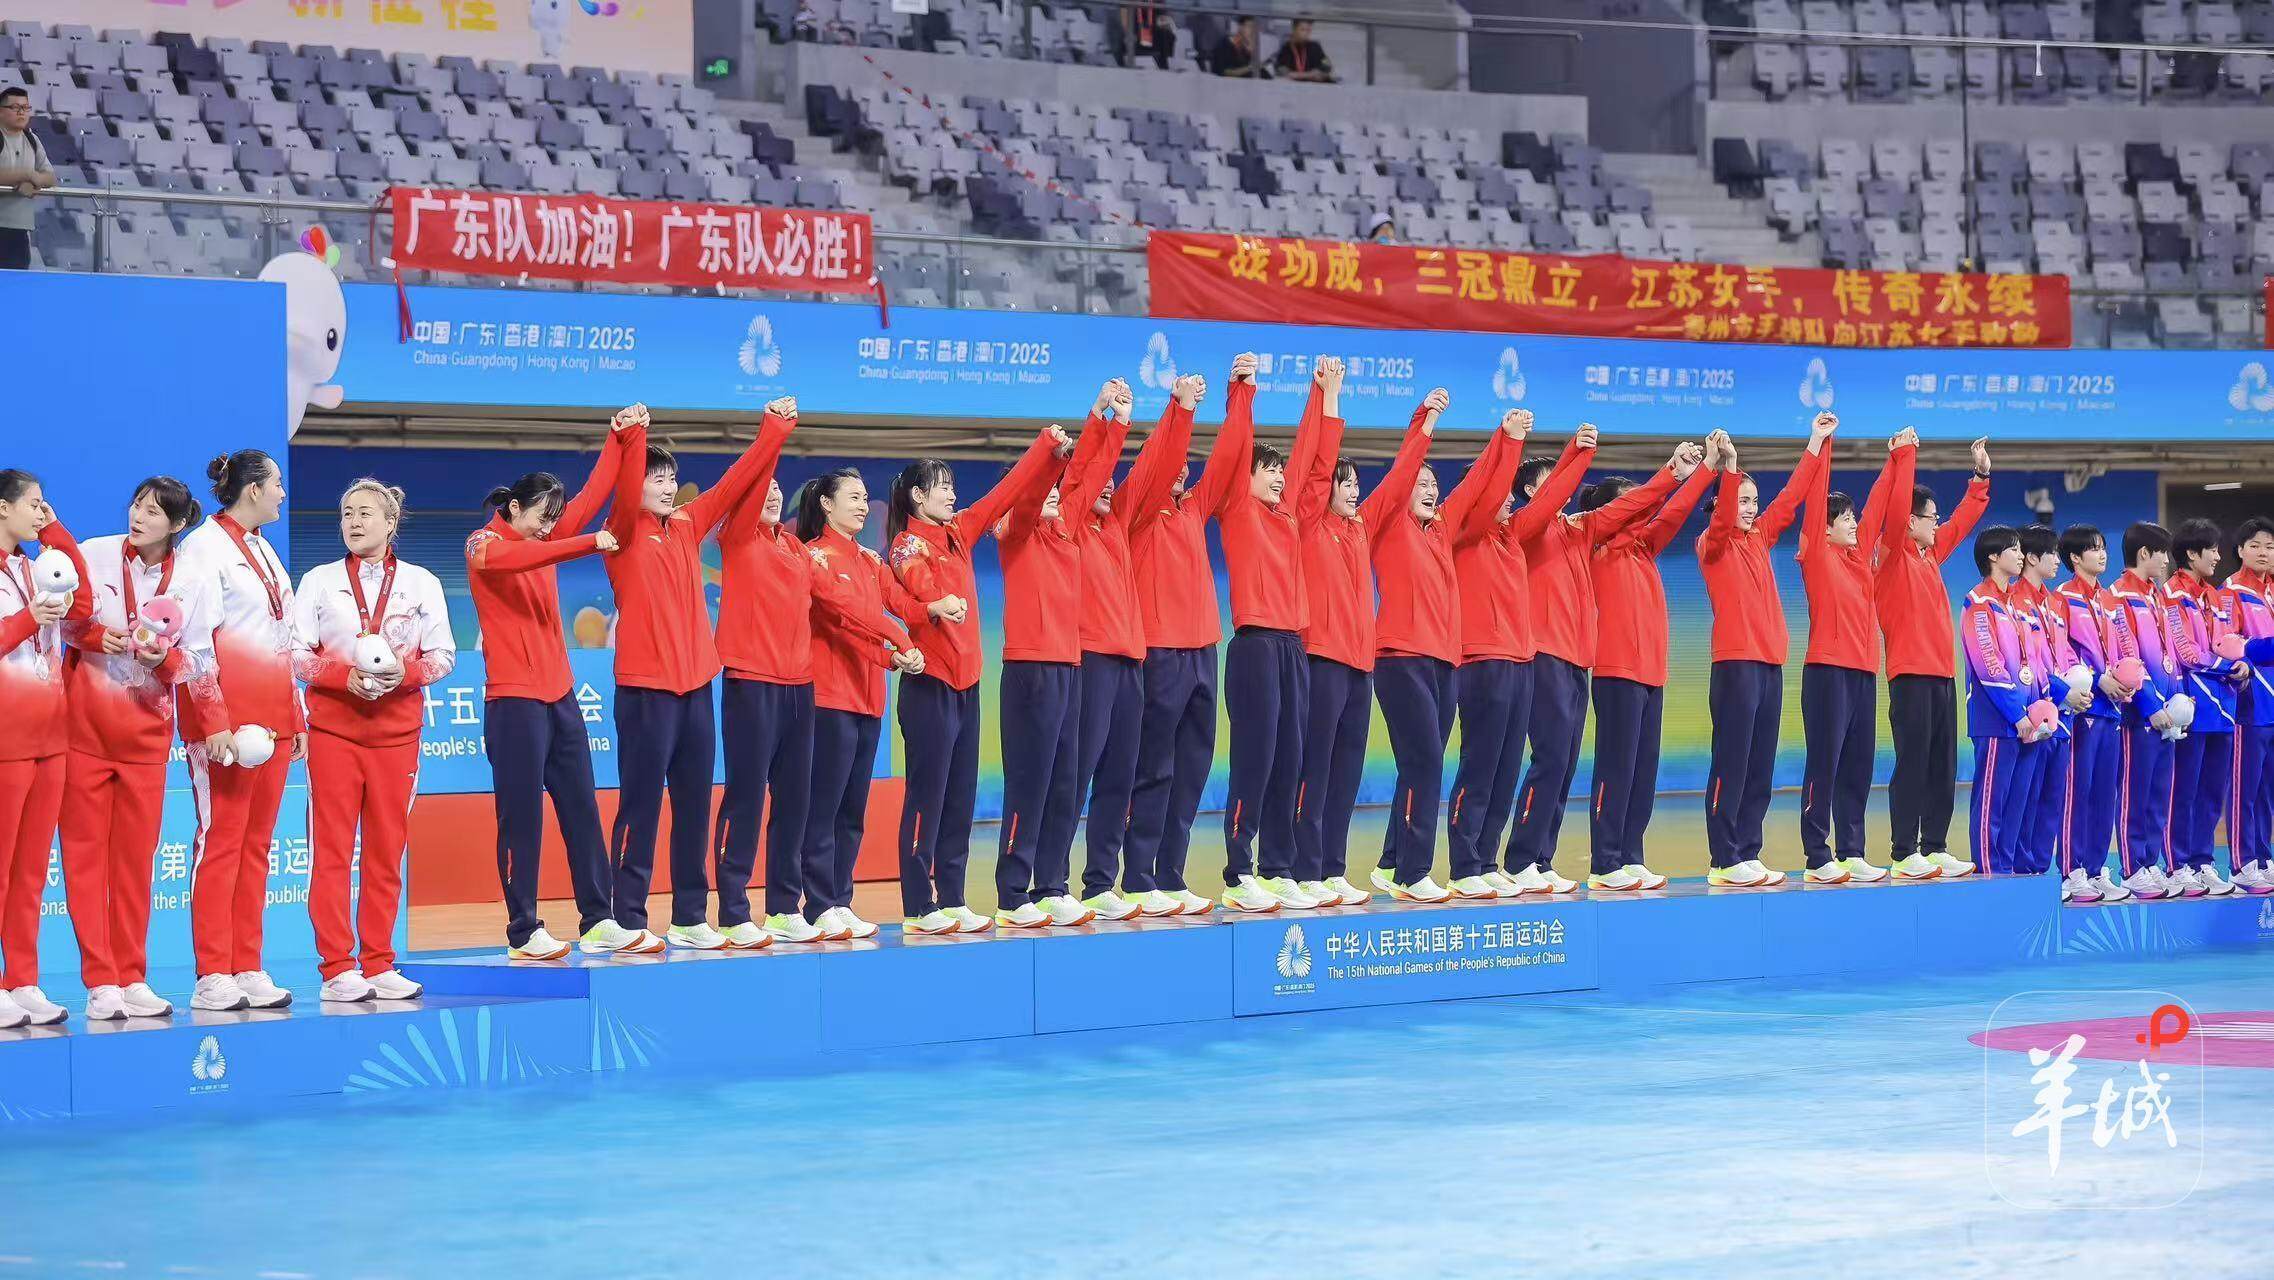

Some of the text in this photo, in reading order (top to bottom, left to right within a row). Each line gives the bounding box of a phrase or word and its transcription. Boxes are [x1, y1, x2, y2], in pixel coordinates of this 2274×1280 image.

[589, 327, 635, 350] 2025
[528, 355, 557, 372] Hong
[561, 356, 589, 372] Kong
[600, 357, 636, 370] Macao
[1010, 343, 1050, 365] 2025
[1377, 358, 1414, 379] 2025
[1701, 369, 1735, 389] 2025
[2067, 375, 2115, 394] 2025
[421, 736, 477, 760] eople's
[153, 891, 177, 910] the
[266, 884, 309, 909] public
[1326, 918, 1565, 960] 中华人民共和国第十五届运动会
[1327, 950, 1566, 979] The 15th National Games of the People's Republic of China
